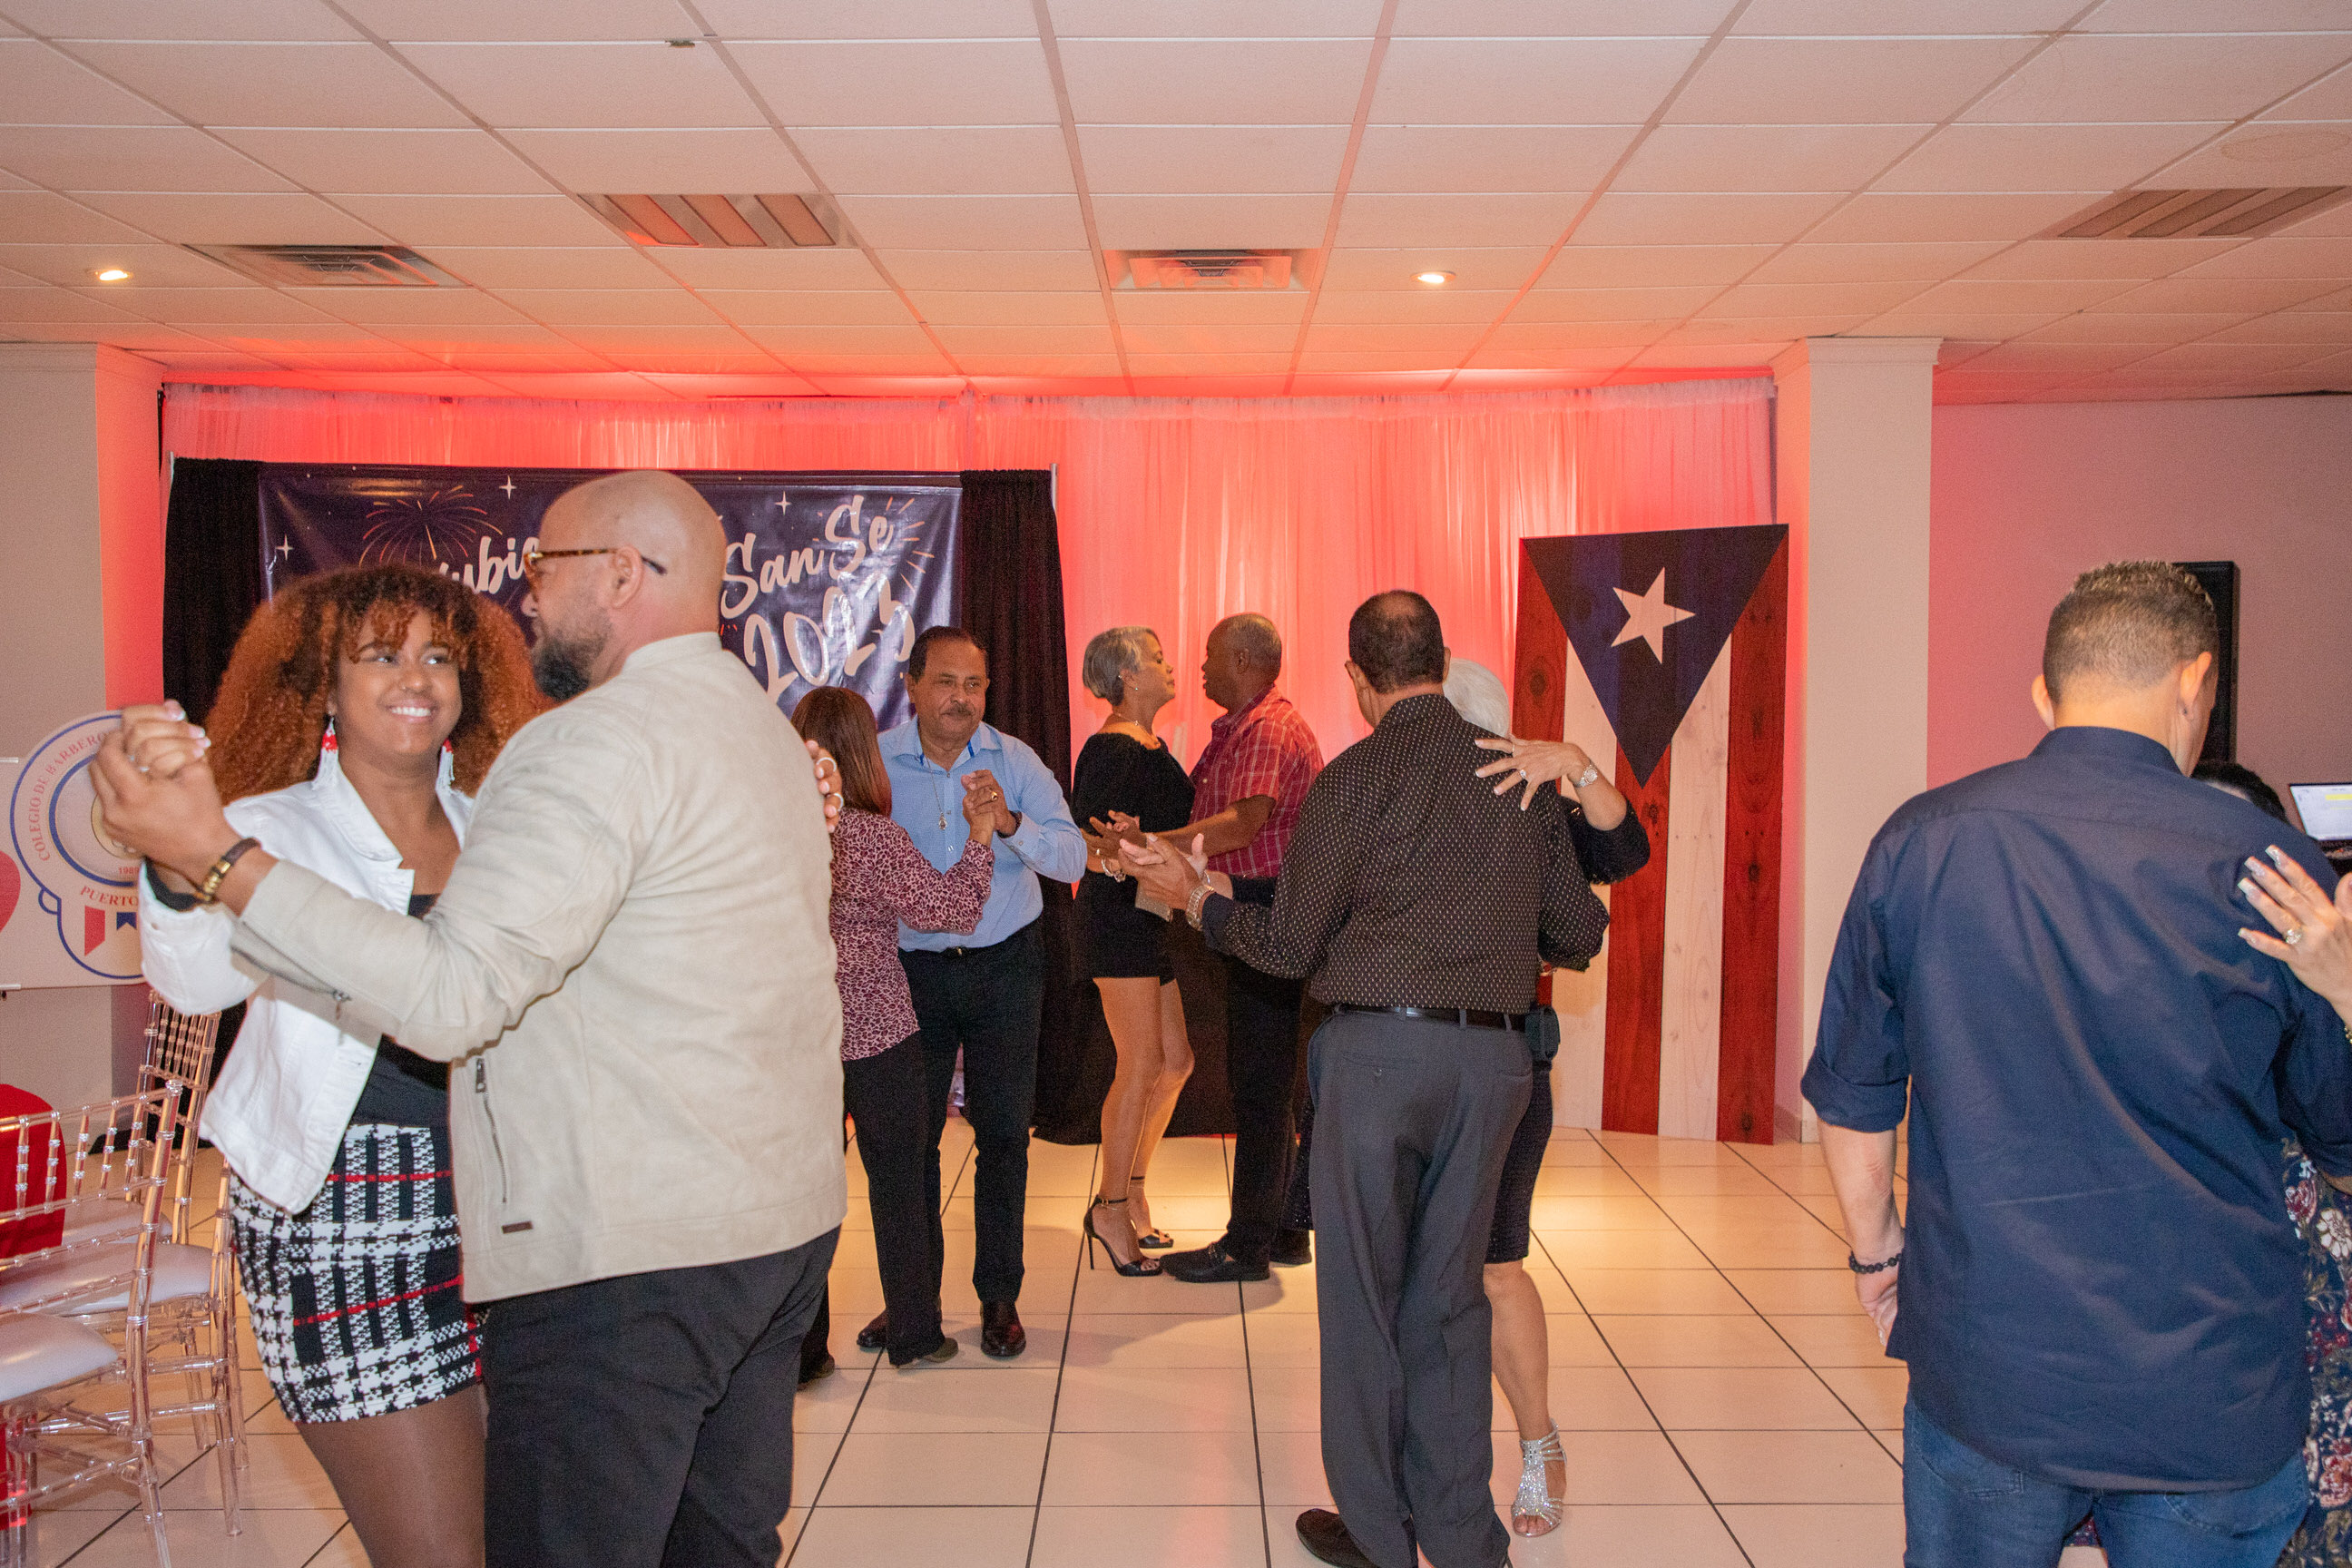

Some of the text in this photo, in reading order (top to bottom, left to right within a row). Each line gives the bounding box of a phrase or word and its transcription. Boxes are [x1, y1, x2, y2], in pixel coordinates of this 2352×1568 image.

[720, 533, 824, 620] San
[825, 495, 894, 580] Se
[743, 571, 916, 704] 2023
[33, 778, 50, 795] DE
[28, 796, 51, 862] COLEGIO
[80, 886, 140, 906] PUERTO
